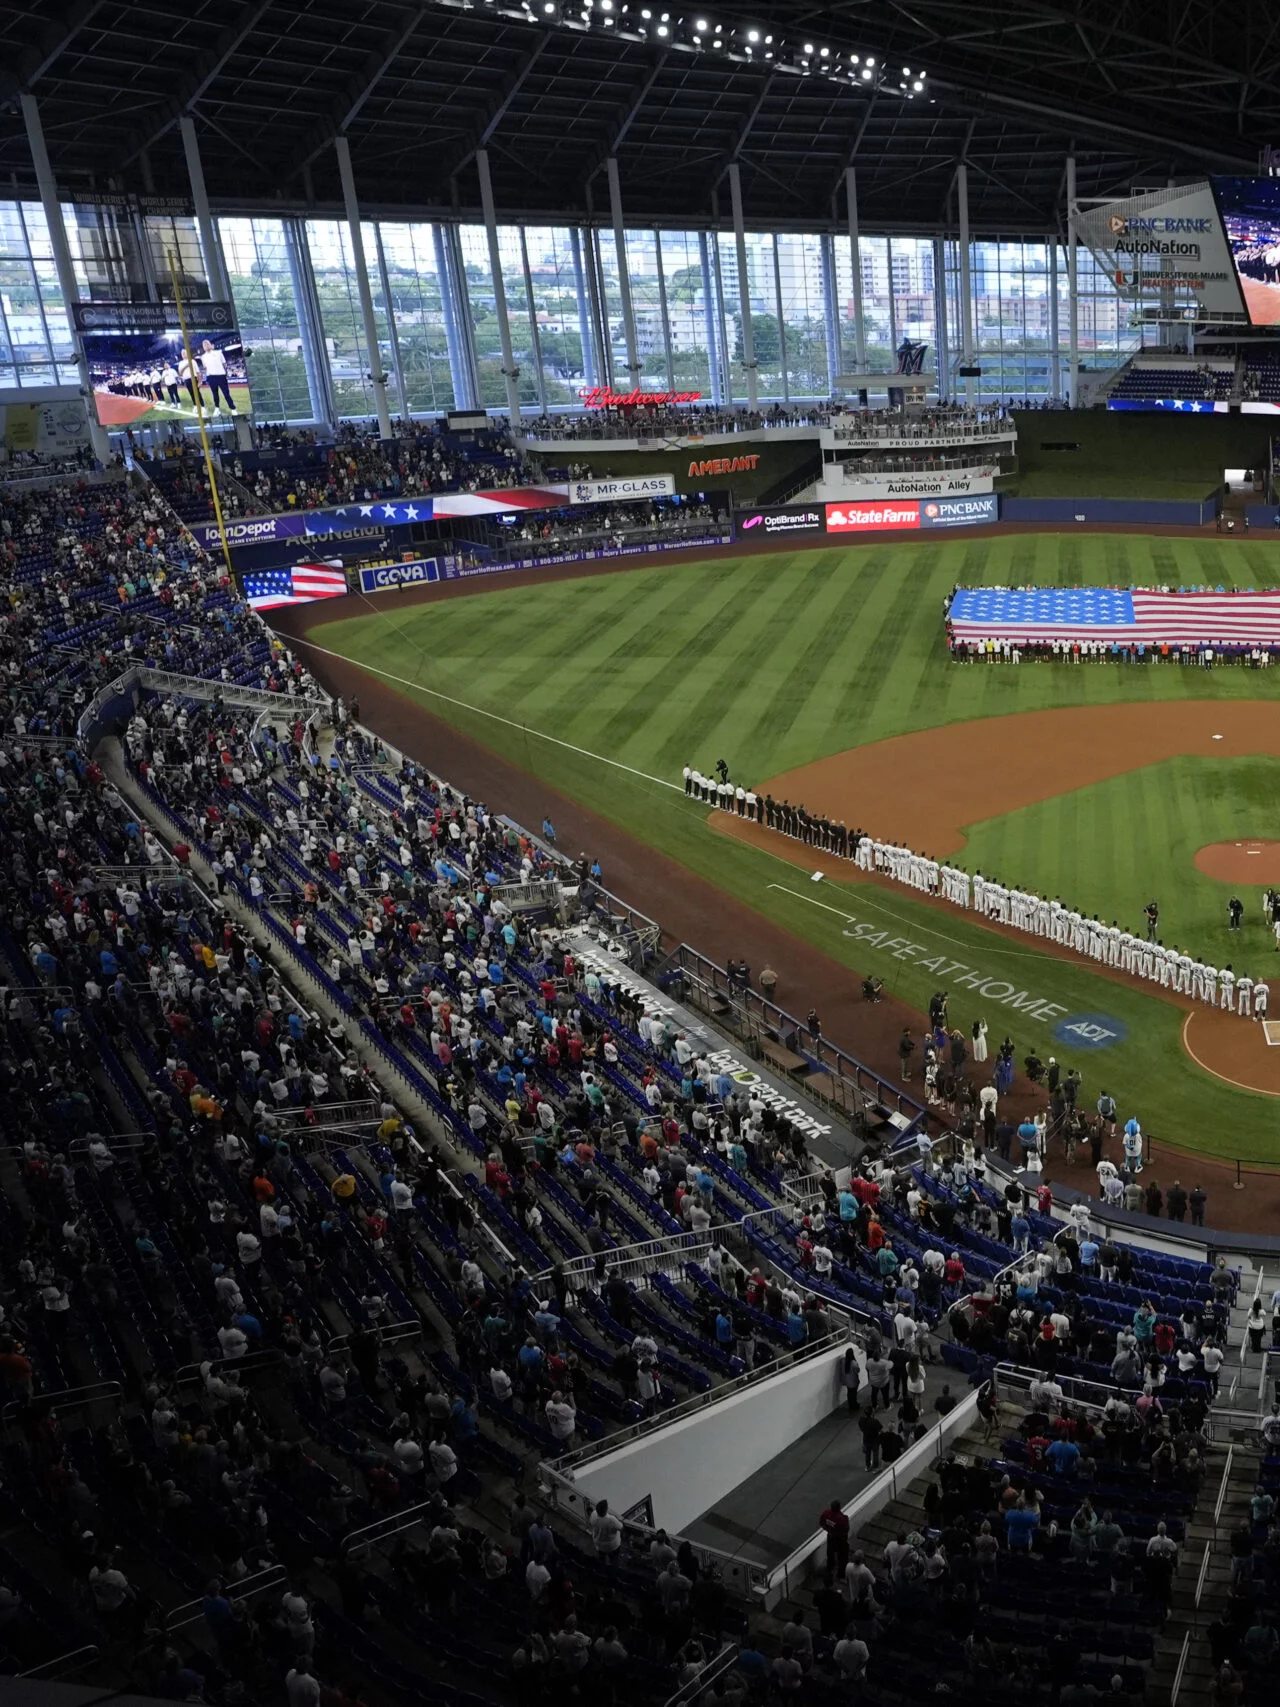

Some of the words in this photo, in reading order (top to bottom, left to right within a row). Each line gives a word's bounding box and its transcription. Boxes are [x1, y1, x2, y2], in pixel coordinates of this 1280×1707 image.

[1115, 240, 1198, 255] AutoNation
[578, 386, 703, 409] Budweiser
[924, 437, 966, 445] PARTNERS
[688, 454, 761, 477] AMERANT
[887, 482, 942, 493] AutoNation
[948, 481, 971, 491] Alley
[939, 503, 964, 516] PNC
[965, 500, 993, 513] BANK
[765, 514, 805, 526] OptiBrand
[377, 566, 424, 584] GOYA
[842, 923, 928, 961] SAFE
[913, 956, 969, 976] AT
[953, 971, 1069, 1022] HOME
[1064, 1021, 1118, 1042] ADT
